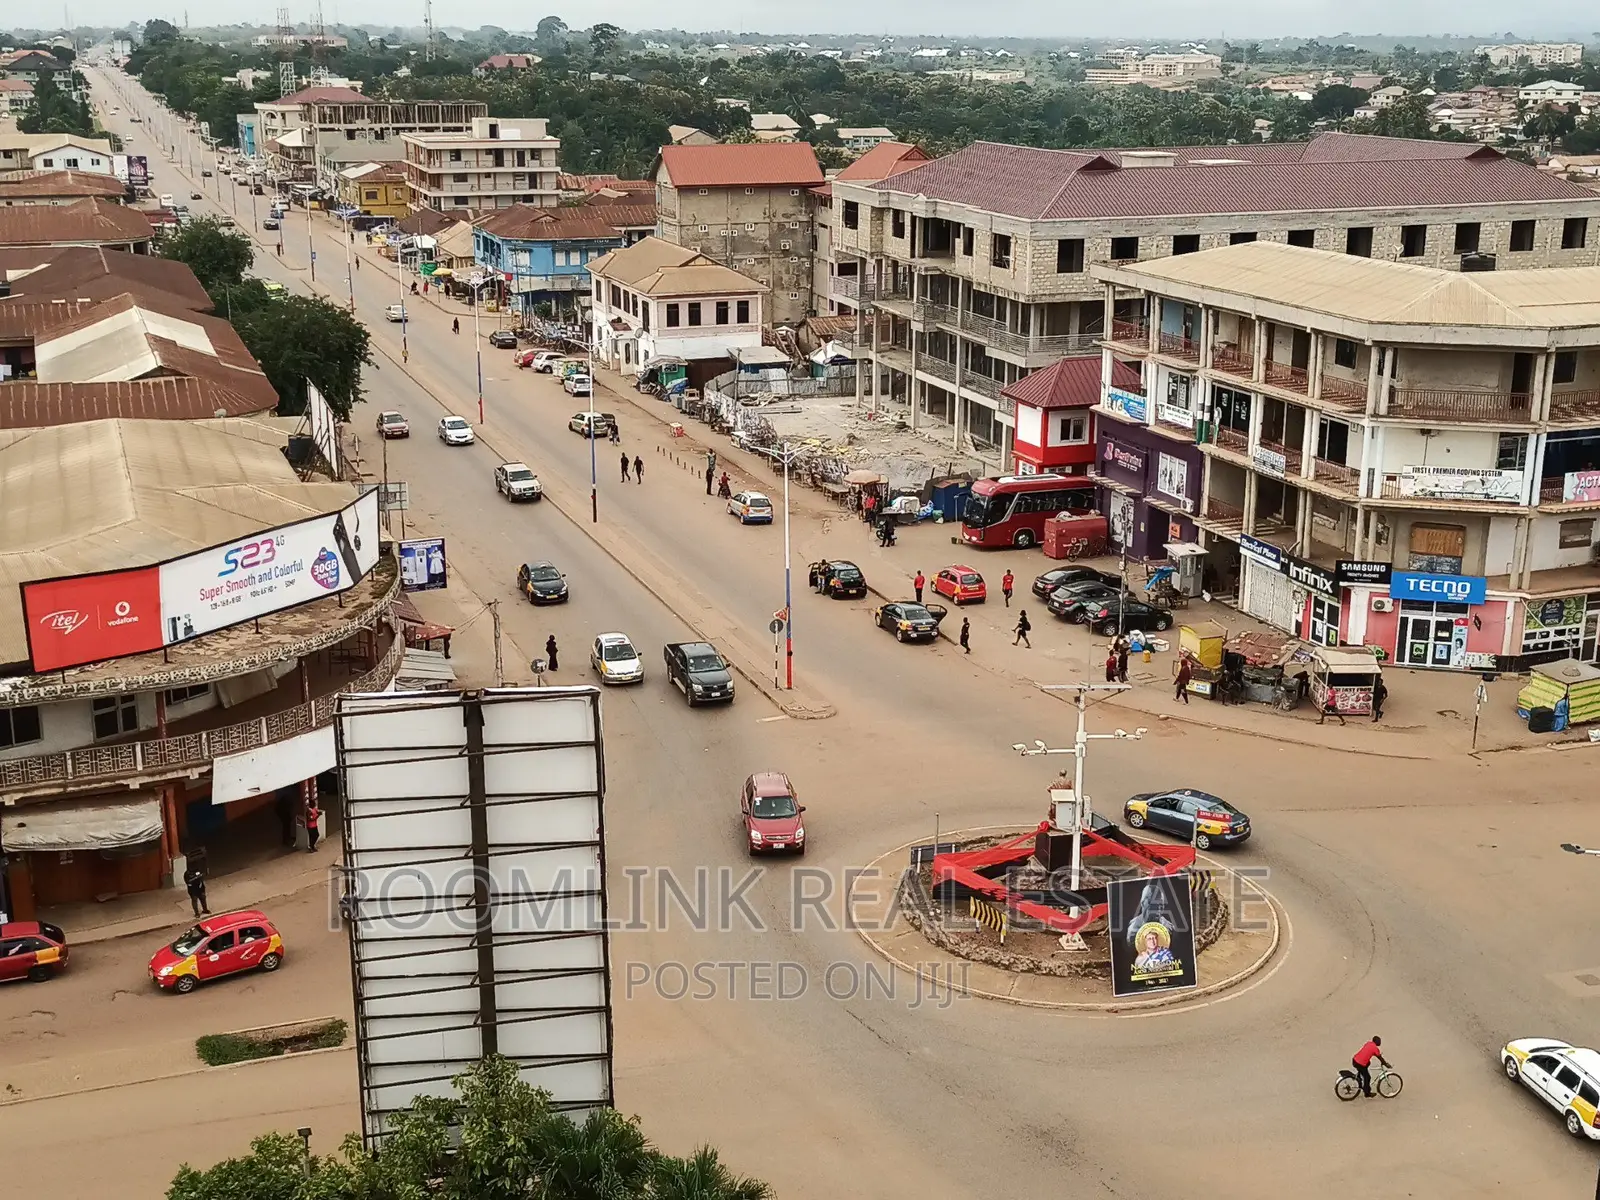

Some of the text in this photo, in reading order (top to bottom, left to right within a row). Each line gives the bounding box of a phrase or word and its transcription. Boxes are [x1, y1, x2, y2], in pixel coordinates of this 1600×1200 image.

[275, 534, 285, 547] 4G
[217, 538, 276, 577] S23
[313, 559, 337, 576] 30GB
[1341, 563, 1386, 572] SAMSUNG
[199, 559, 304, 602] Super Smooth and Colorful
[1289, 561, 1333, 594] Infinix
[1406, 578, 1471, 593] TECNO
[52, 612, 79, 627] itel
[107, 615, 139, 627] vodafone
